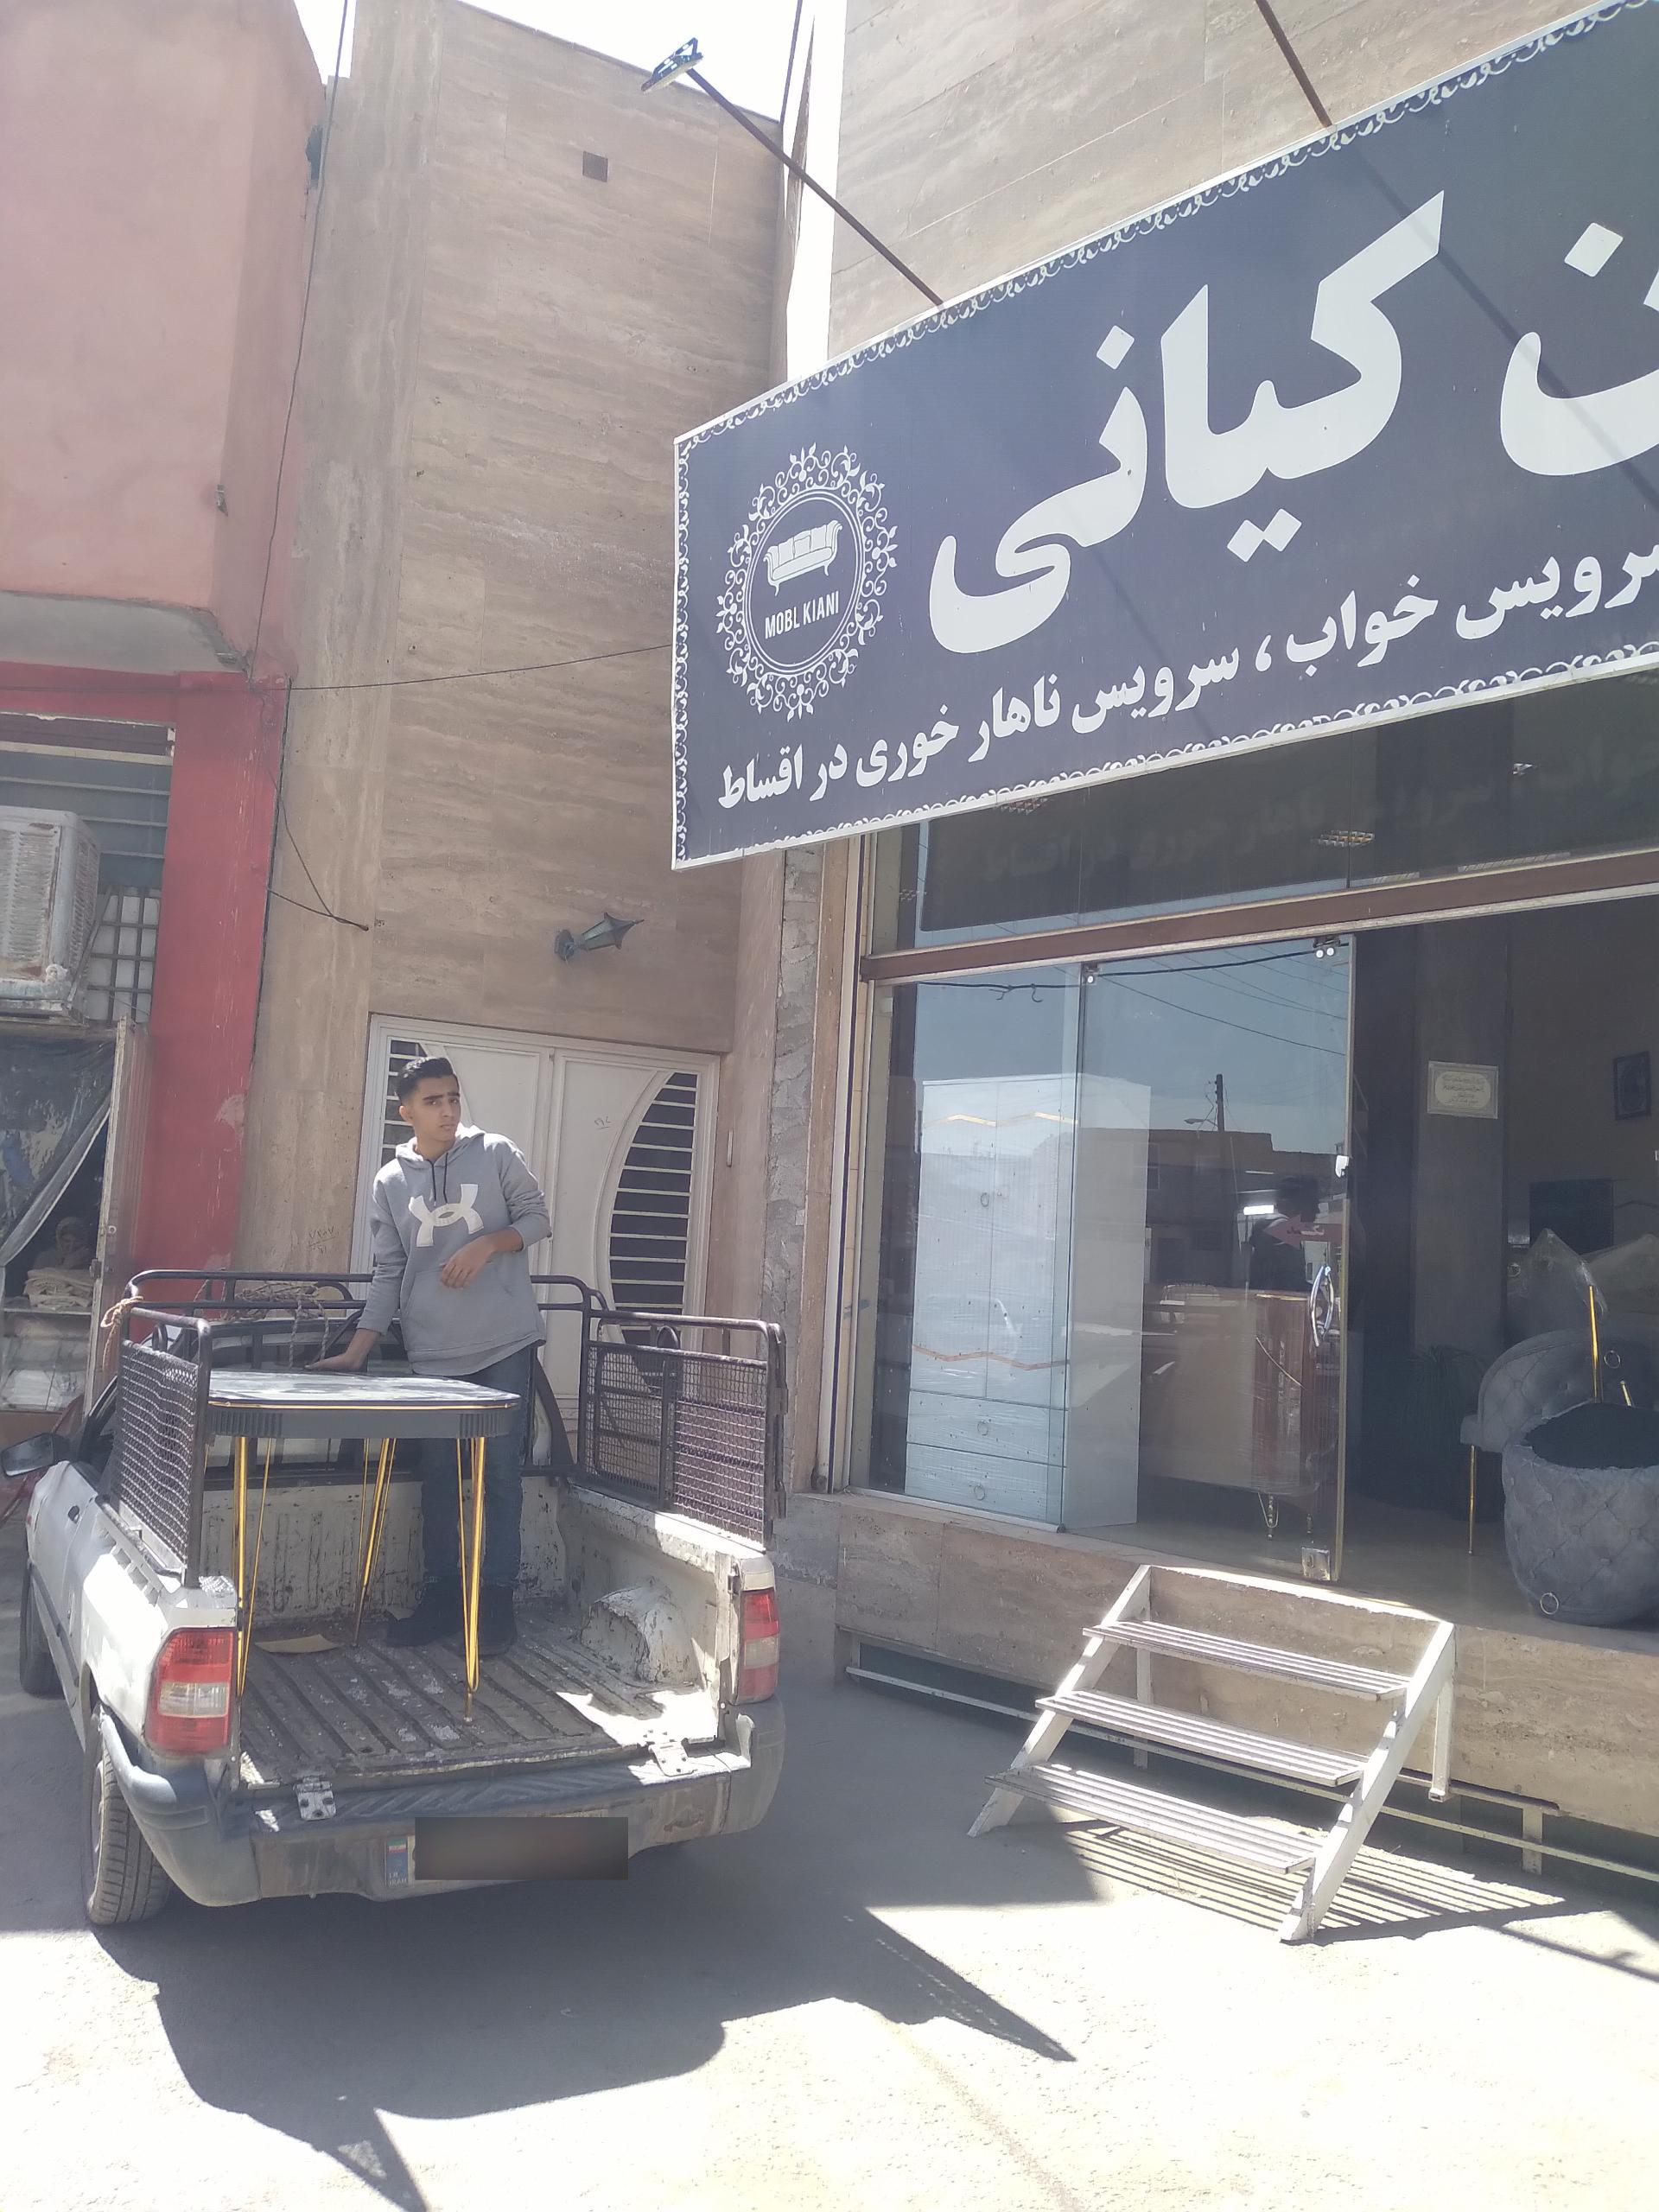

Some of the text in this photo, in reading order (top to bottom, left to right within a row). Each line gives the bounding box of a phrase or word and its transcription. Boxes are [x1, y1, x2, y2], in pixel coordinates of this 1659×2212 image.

[930, 190, 1444, 653] کیانی
[765, 589, 840, 639] MOBL KIANI
[1456, 545, 1659, 639] رویس
[1072, 647, 1239, 734] سرویس
[718, 744, 803, 809] اقساط
[810, 744, 847, 801] در
[856, 704, 959, 786] خوری
